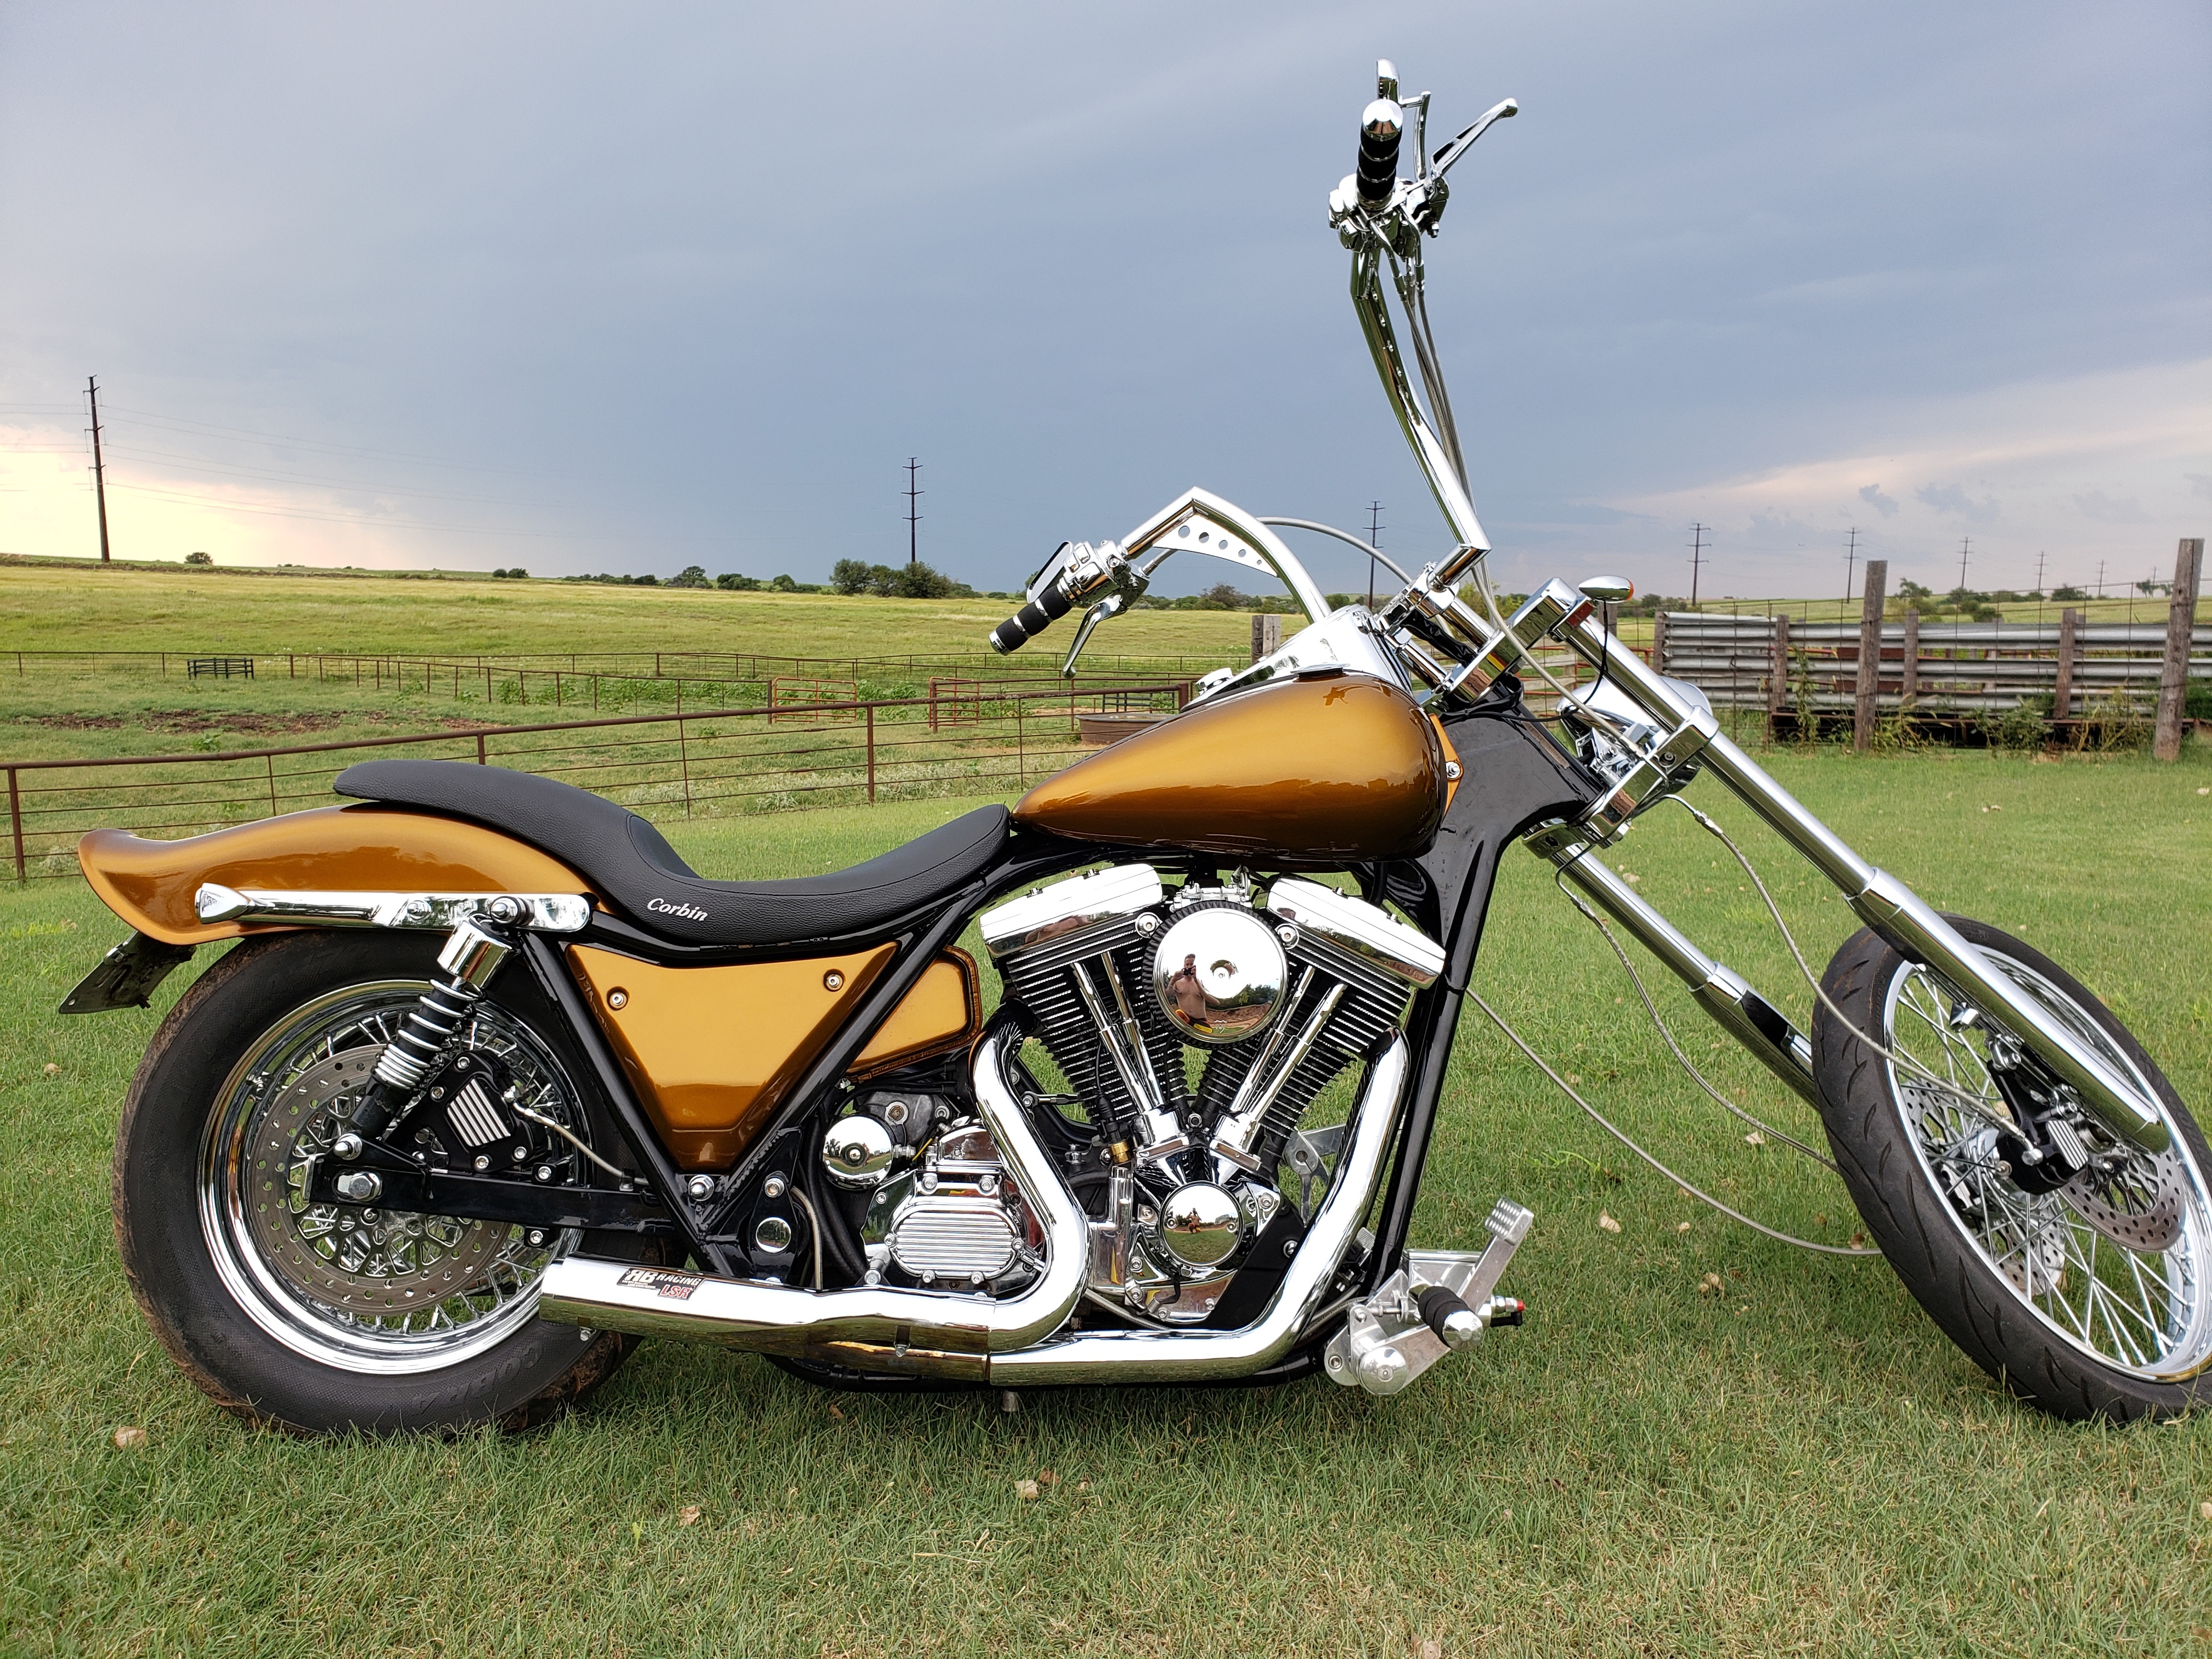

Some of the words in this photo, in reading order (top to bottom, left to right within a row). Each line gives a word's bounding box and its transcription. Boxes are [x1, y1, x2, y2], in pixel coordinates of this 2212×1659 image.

[647, 898, 708, 921] Corbin
[656, 1273, 702, 1285] RACING
[660, 1284, 691, 1299] LSR
[411, 1341, 543, 1416] COBRA
